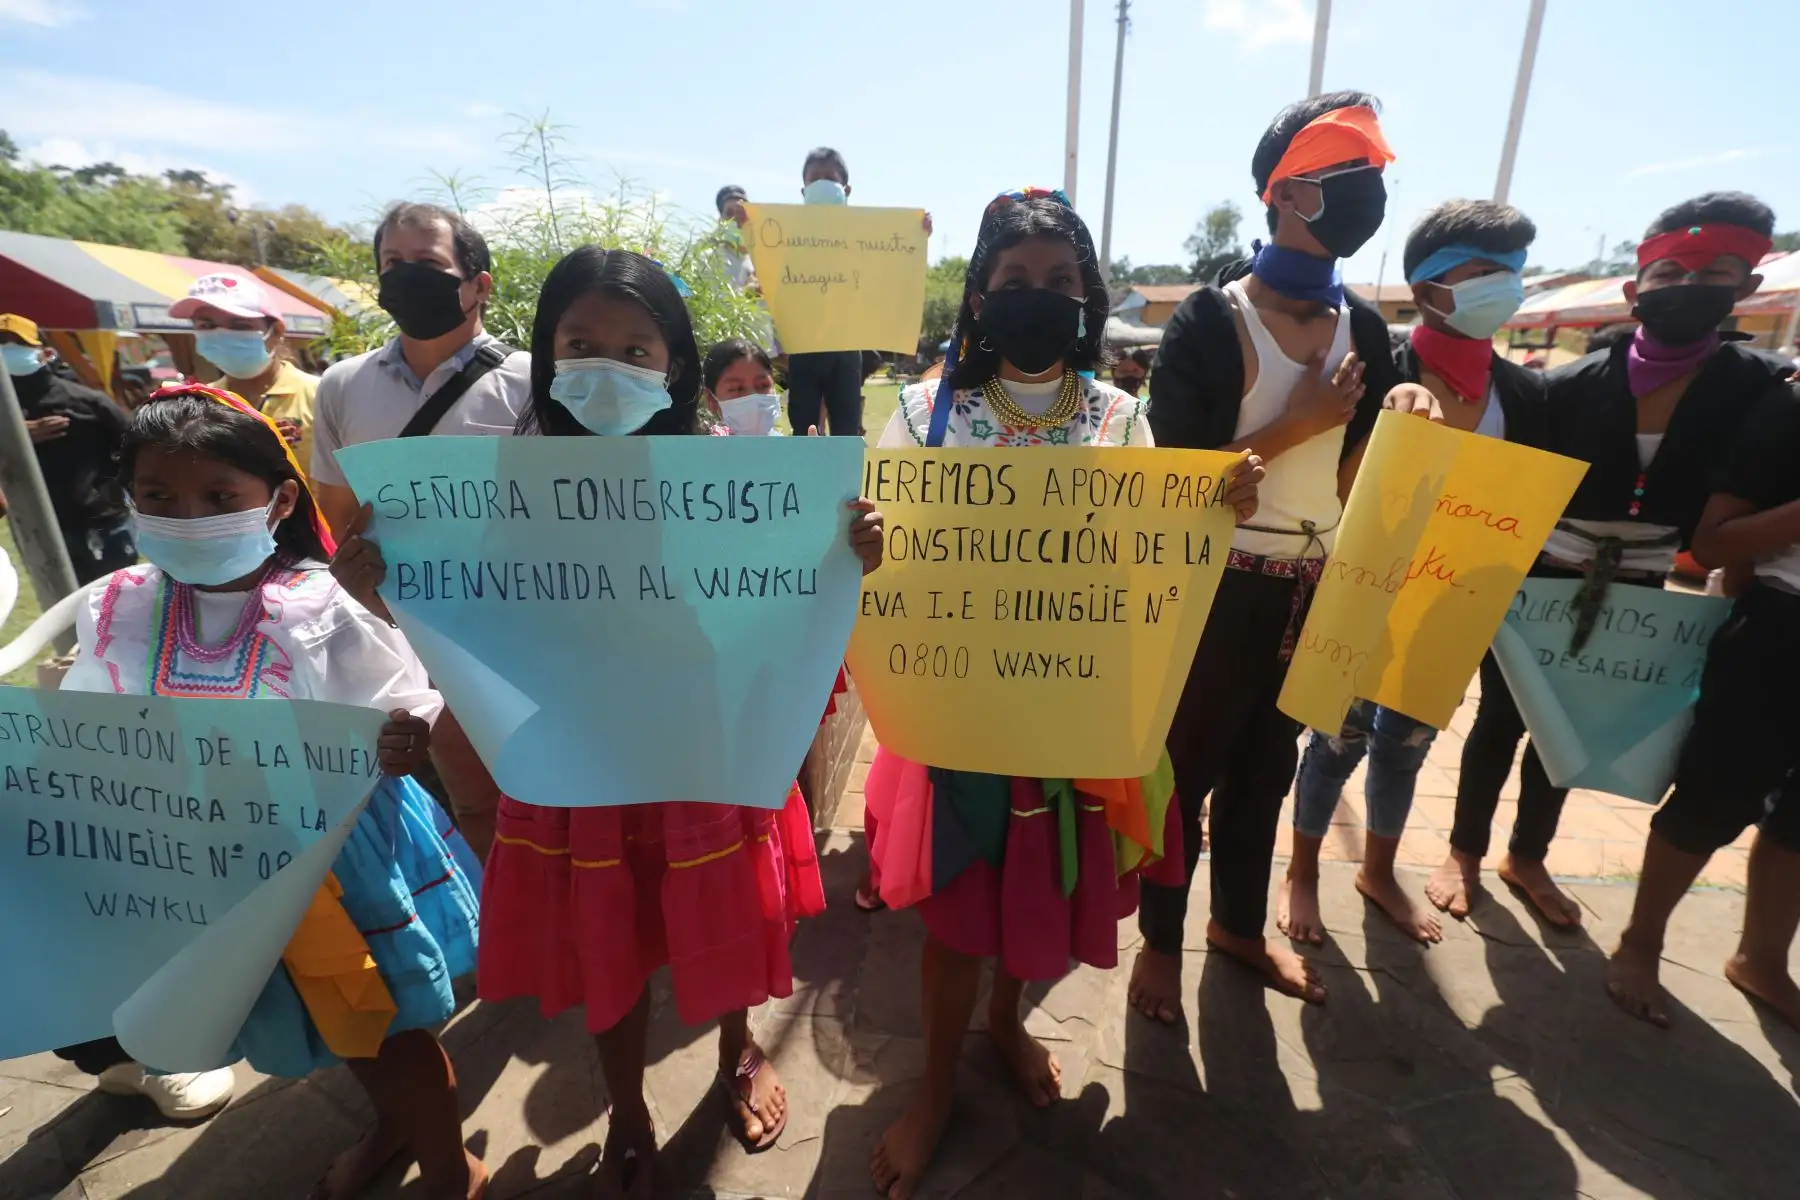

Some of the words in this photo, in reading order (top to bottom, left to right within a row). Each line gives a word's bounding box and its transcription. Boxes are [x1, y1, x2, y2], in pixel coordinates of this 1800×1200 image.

[761, 217, 848, 250] Queremos
[378, 475, 531, 521] SEÑORA
[554, 478, 801, 523] CONGRESISTA
[1043, 468, 1143, 508] APOYO
[1161, 473, 1226, 509] PARA
[1132, 531, 1165, 565] DE
[1185, 531, 1211, 566] LA
[398, 559, 615, 601] BIENVENIDA
[639, 564, 676, 601] AL
[694, 566, 817, 598] WAYKU
[927, 590, 975, 620] I.E
[994, 584, 1129, 623] BILINGÜE
[889, 643, 969, 679] 0800
[993, 648, 1100, 679] WAYKU.
[1538, 648, 1669, 685] DESAGÜE
[196, 737, 231, 766] DE
[254, 741, 290, 768] LA
[303, 741, 382, 779] NUEV
[5, 765, 226, 822] AESTRUCTURA
[245, 801, 279, 825] DE
[300, 806, 327, 832] LA
[26, 819, 195, 876] BILINGÜE
[84, 891, 208, 925] WAYKU
